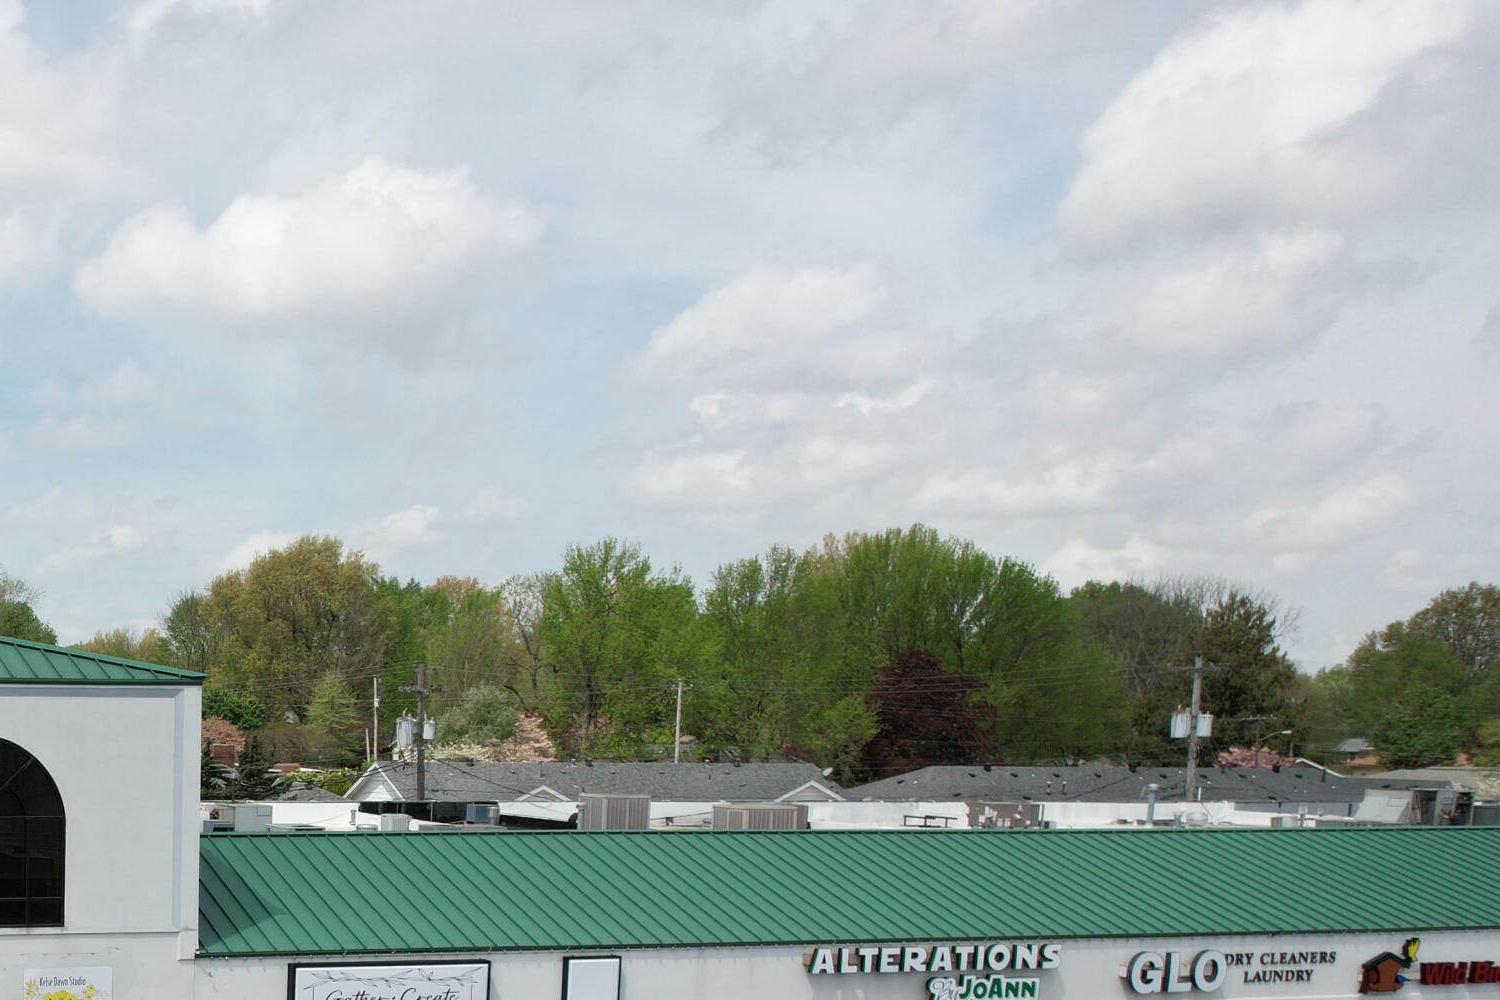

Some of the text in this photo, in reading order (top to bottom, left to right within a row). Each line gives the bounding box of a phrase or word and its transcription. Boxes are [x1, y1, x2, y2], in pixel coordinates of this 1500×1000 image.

[810, 944, 1063, 974] ALTERATIONS
[1224, 951, 1337, 966] DRY CLEANERS
[54, 976, 68, 986] Dawn
[69, 975, 86, 986] Studio
[1128, 950, 1228, 994] GLO
[1243, 969, 1314, 983] LAUNDRY
[1421, 961, 1468, 985] Wild
